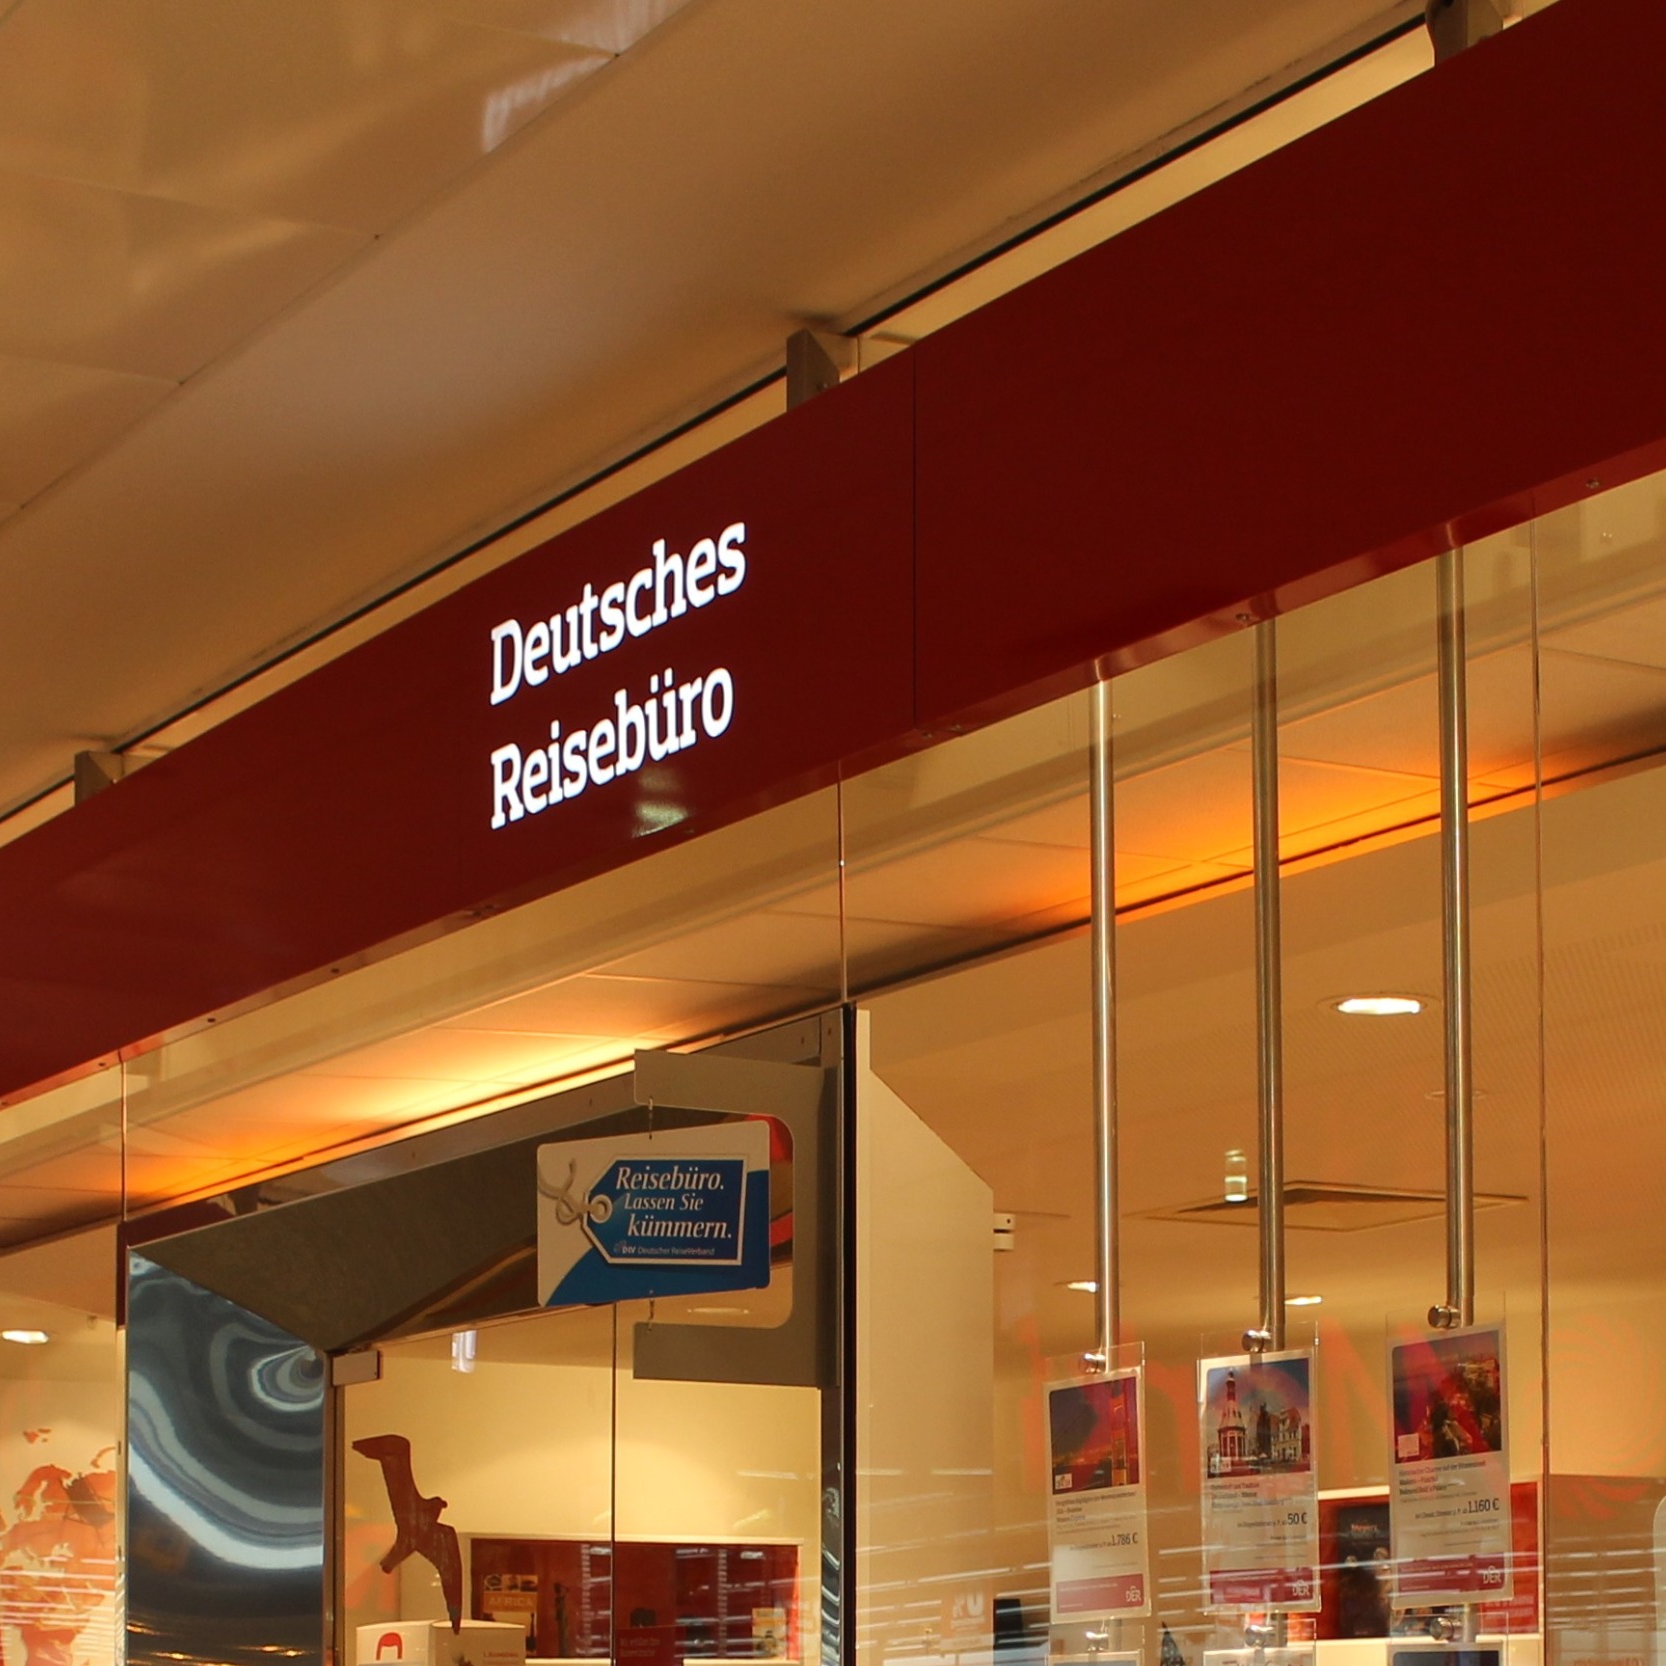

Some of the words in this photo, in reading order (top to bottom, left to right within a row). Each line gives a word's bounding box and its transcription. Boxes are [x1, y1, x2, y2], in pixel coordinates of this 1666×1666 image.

[490, 522, 746, 706] Deutsches
[490, 667, 733, 829] Reisebüro
[615, 1165, 725, 1191] Reisebüro.
[623, 1192, 675, 1211] Lassen
[679, 1193, 704, 1211] Sie
[627, 1213, 733, 1239] kümmern.
